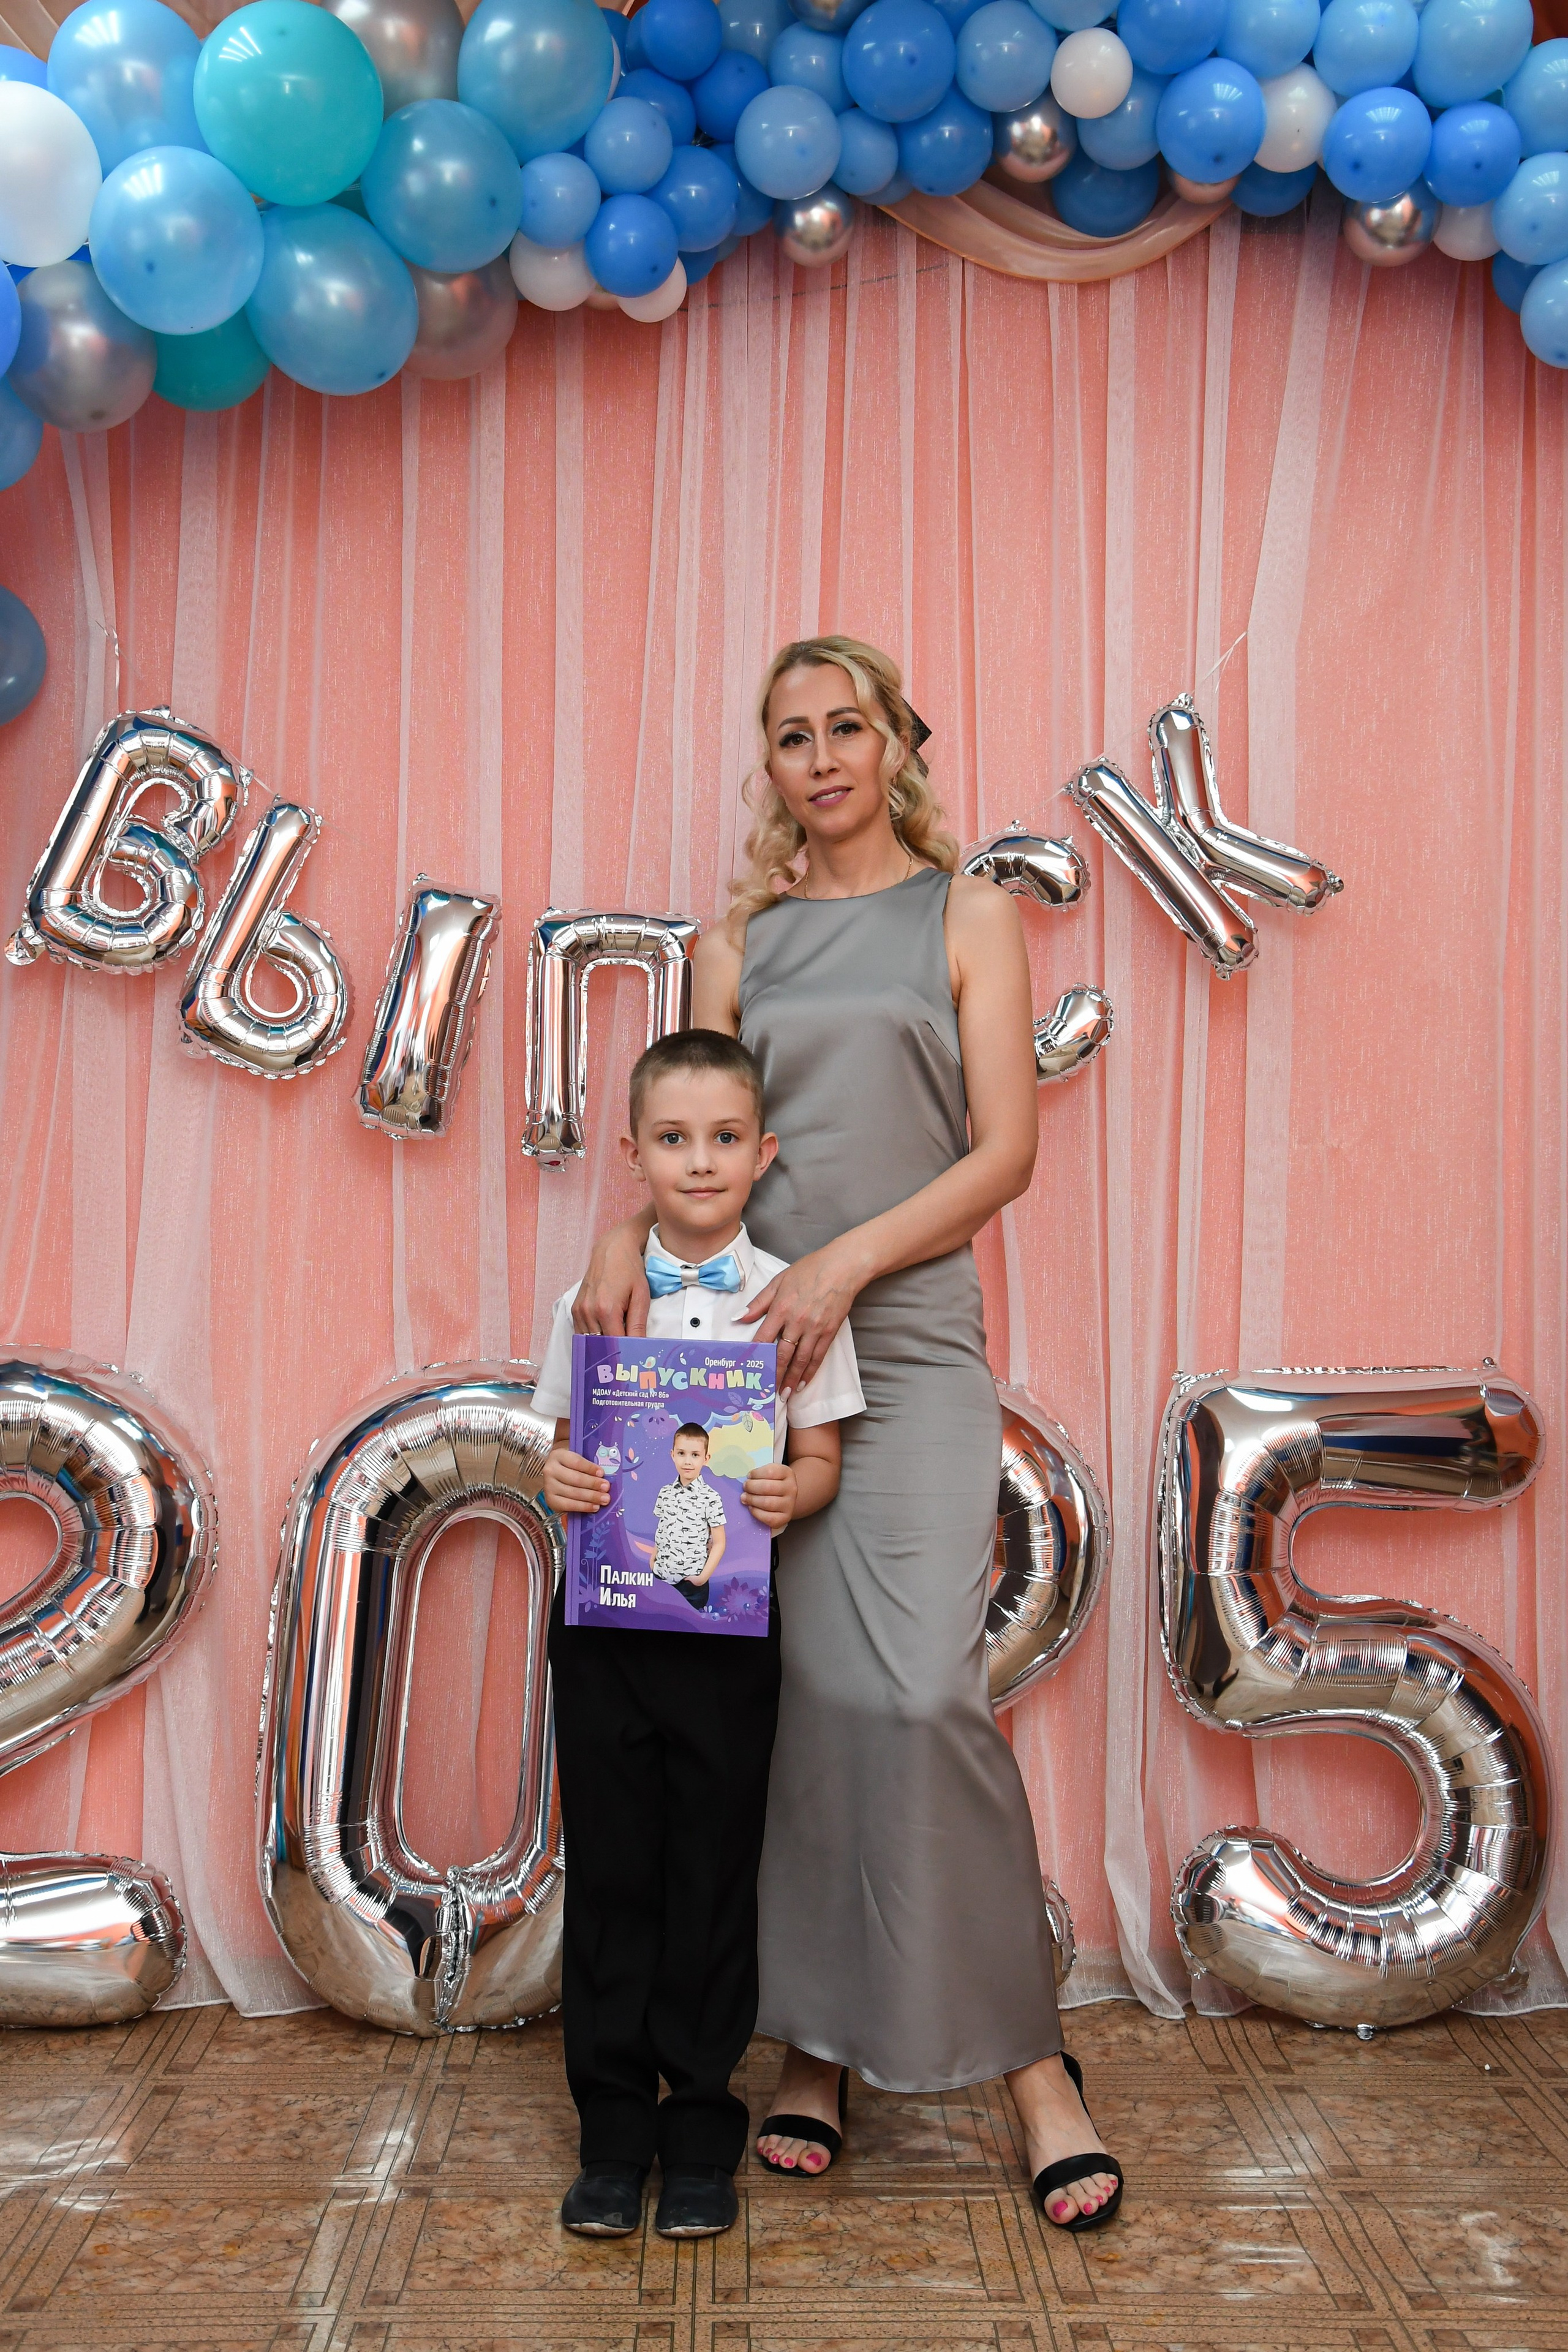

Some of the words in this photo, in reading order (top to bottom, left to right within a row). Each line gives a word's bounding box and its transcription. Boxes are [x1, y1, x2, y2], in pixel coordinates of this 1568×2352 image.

[5, 694, 1344, 1173] ВЫПК
[704, 1356, 736, 1368] Оренбург
[746, 1360, 764, 1369] 2025
[592, 1388, 611, 1396] МДОАУ
[612, 1390, 638, 1398] «Детский
[592, 1398, 644, 1408] Подготовительная
[0, 1344, 1550, 2040] 205
